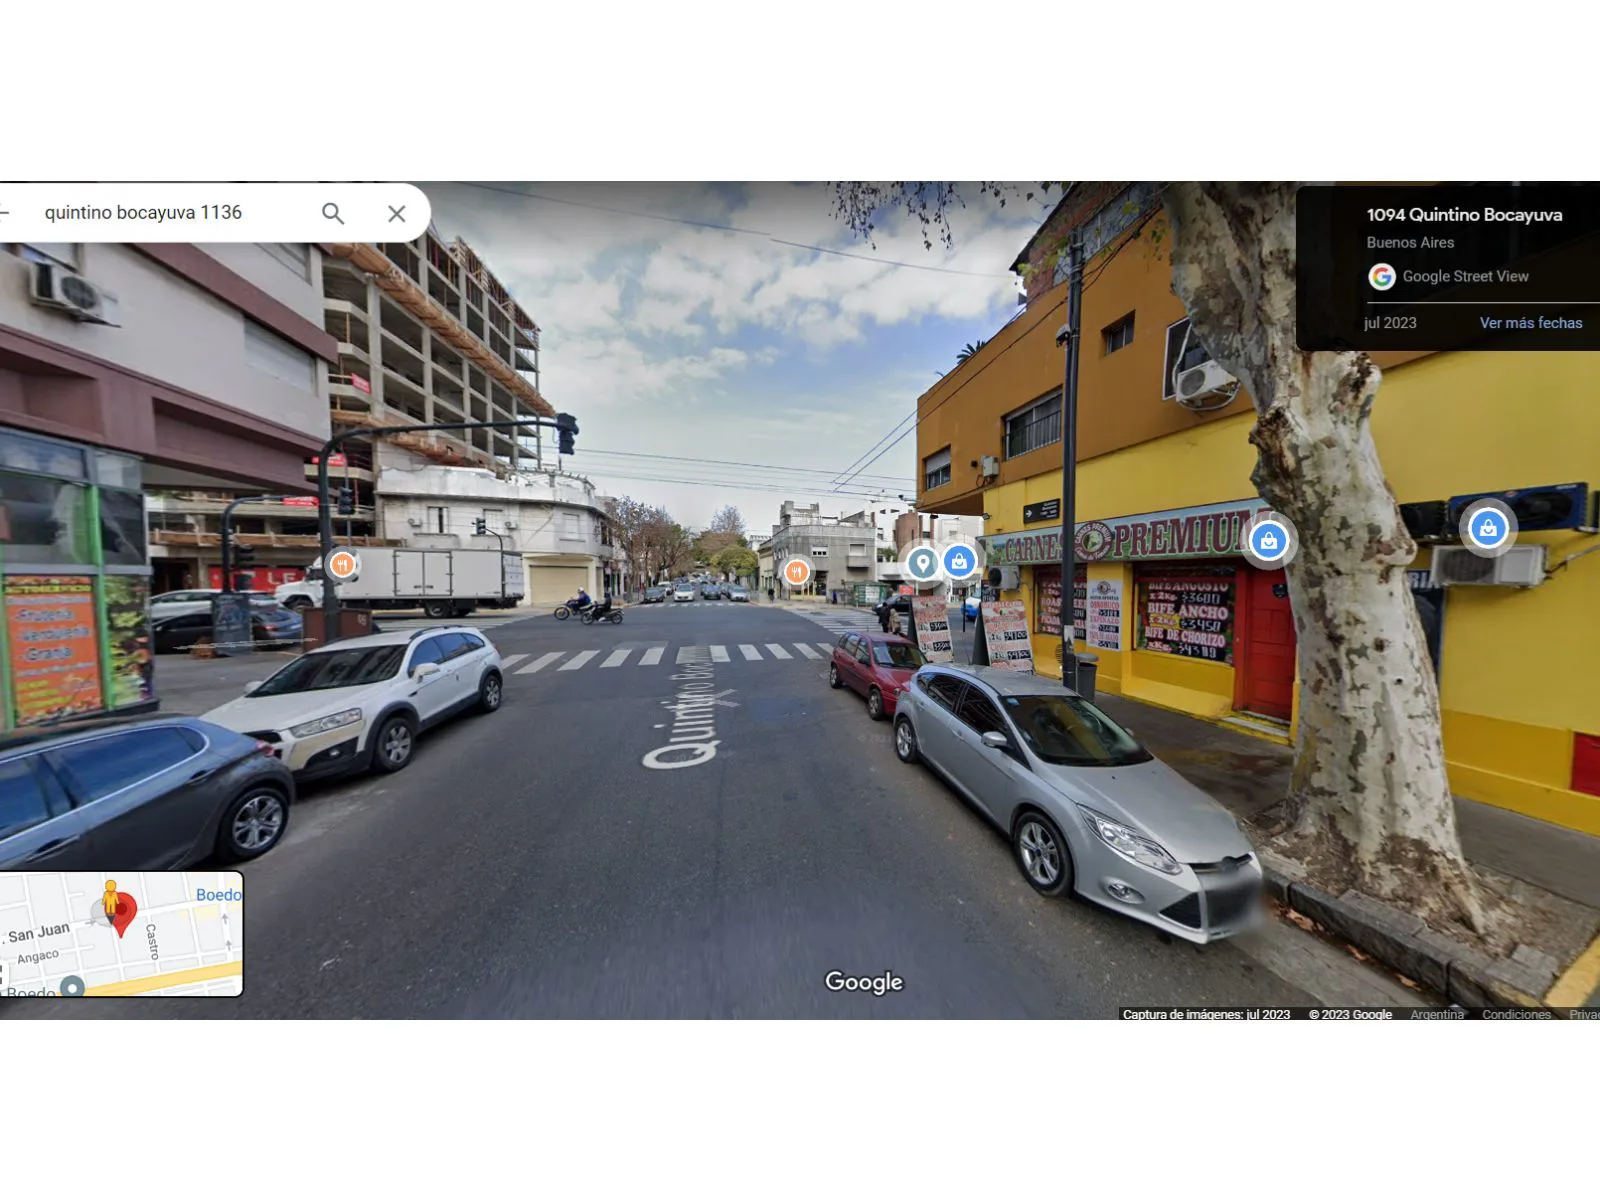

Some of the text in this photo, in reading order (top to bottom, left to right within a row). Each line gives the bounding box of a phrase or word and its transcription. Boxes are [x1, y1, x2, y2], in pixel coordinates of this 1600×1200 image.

[1147, 602, 1229, 620] BIFE ANCHO
[1145, 626, 1226, 648] BIFE DE CHORIZO
